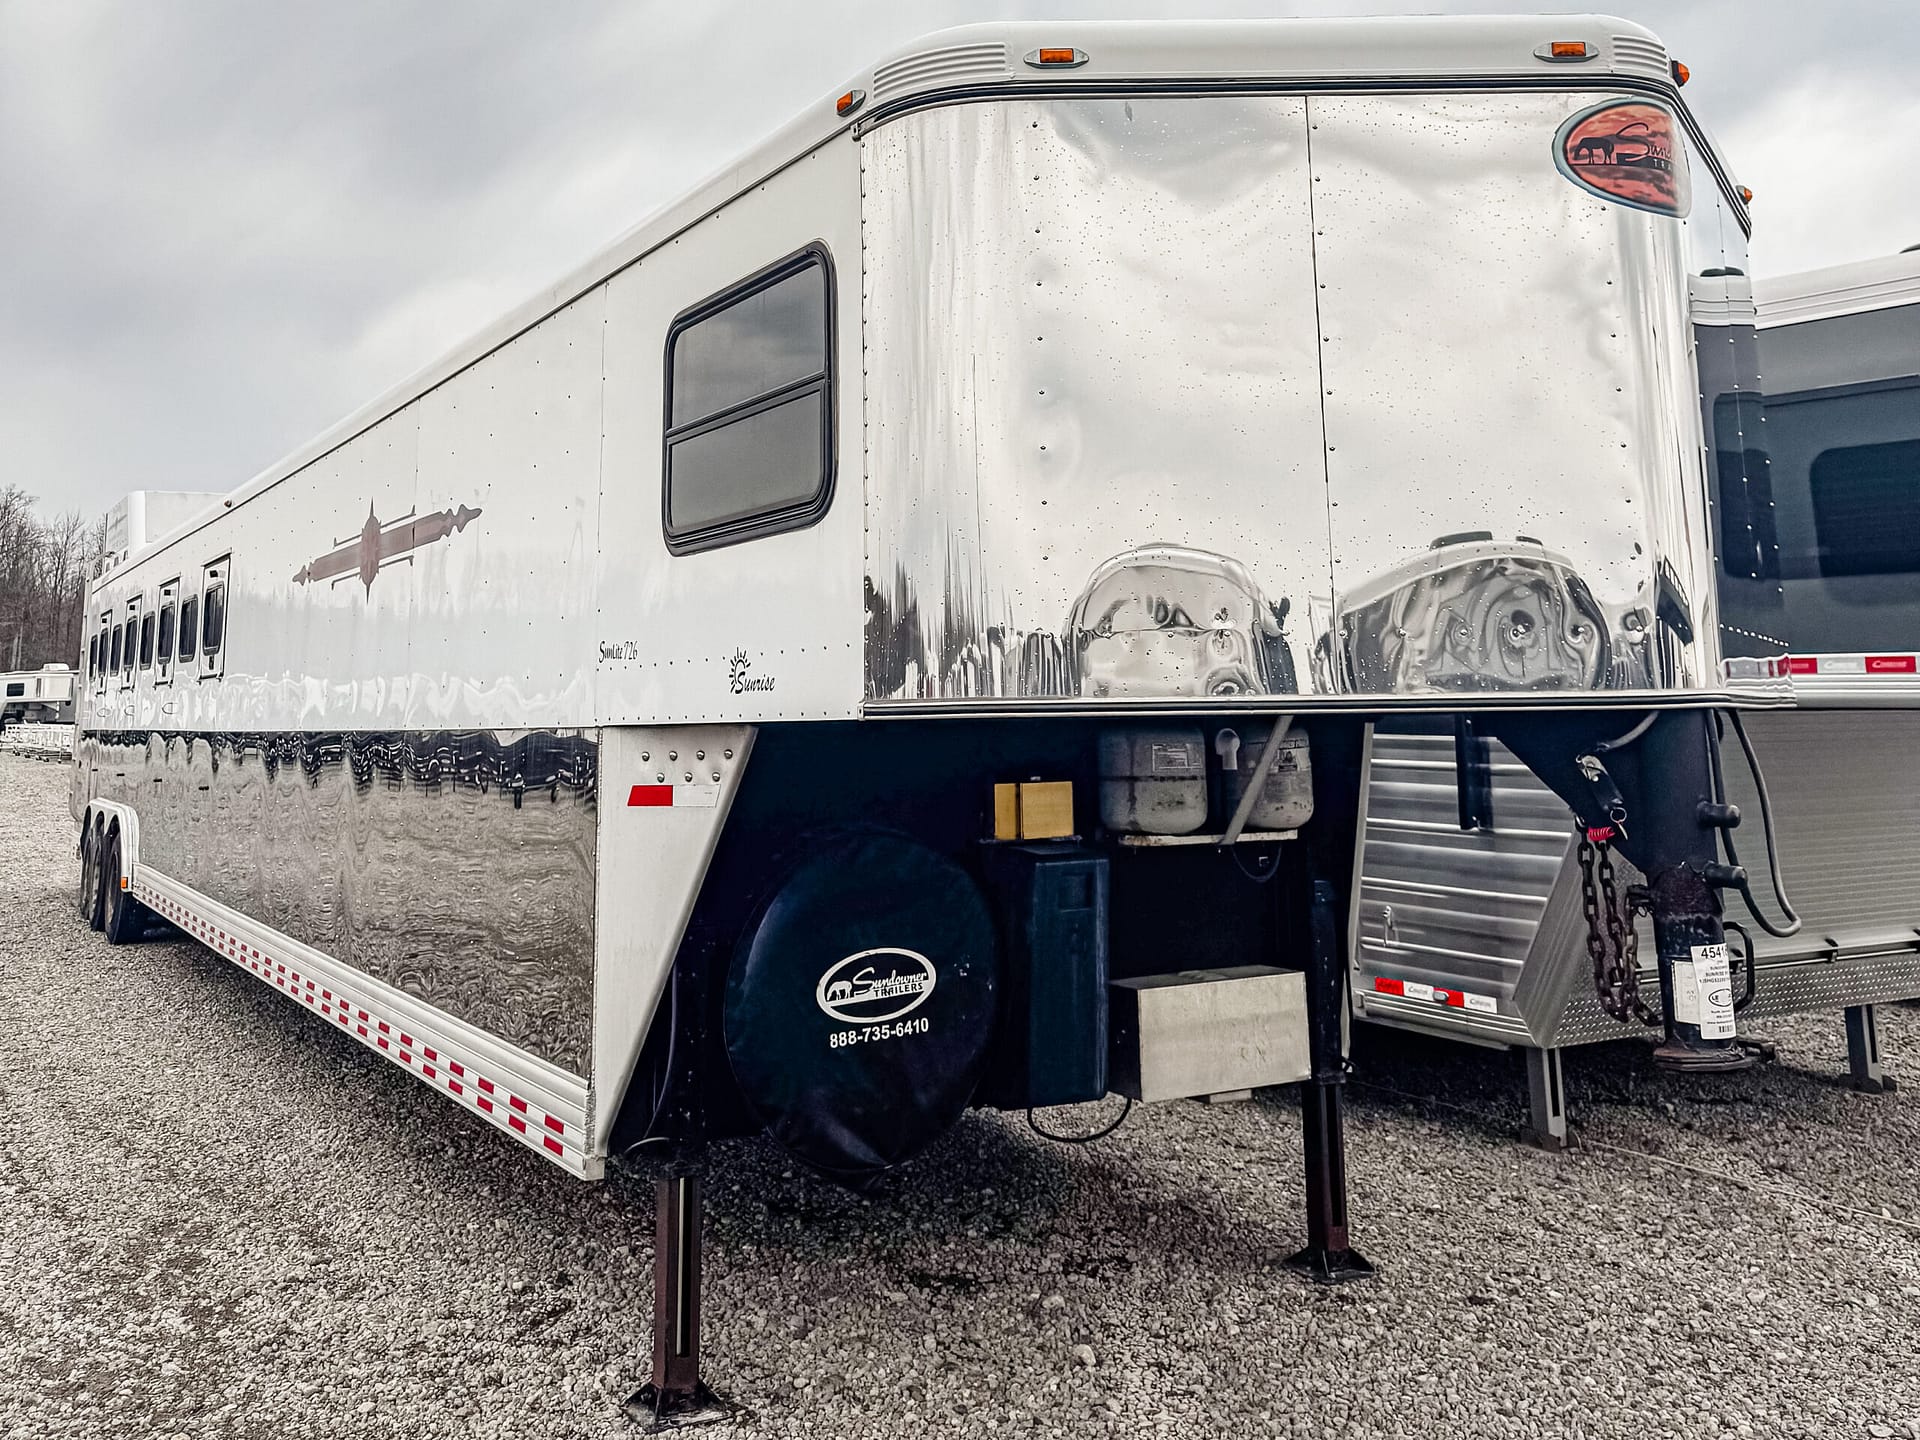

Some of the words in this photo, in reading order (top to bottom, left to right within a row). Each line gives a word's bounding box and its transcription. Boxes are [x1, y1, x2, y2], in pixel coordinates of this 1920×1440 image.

[623, 640, 638, 660] 726
[734, 659, 776, 695] Sunrise
[852, 966, 928, 996] Sundowner
[873, 981, 924, 999] TRAILERS
[829, 1017, 930, 1049] 888-735-6410
